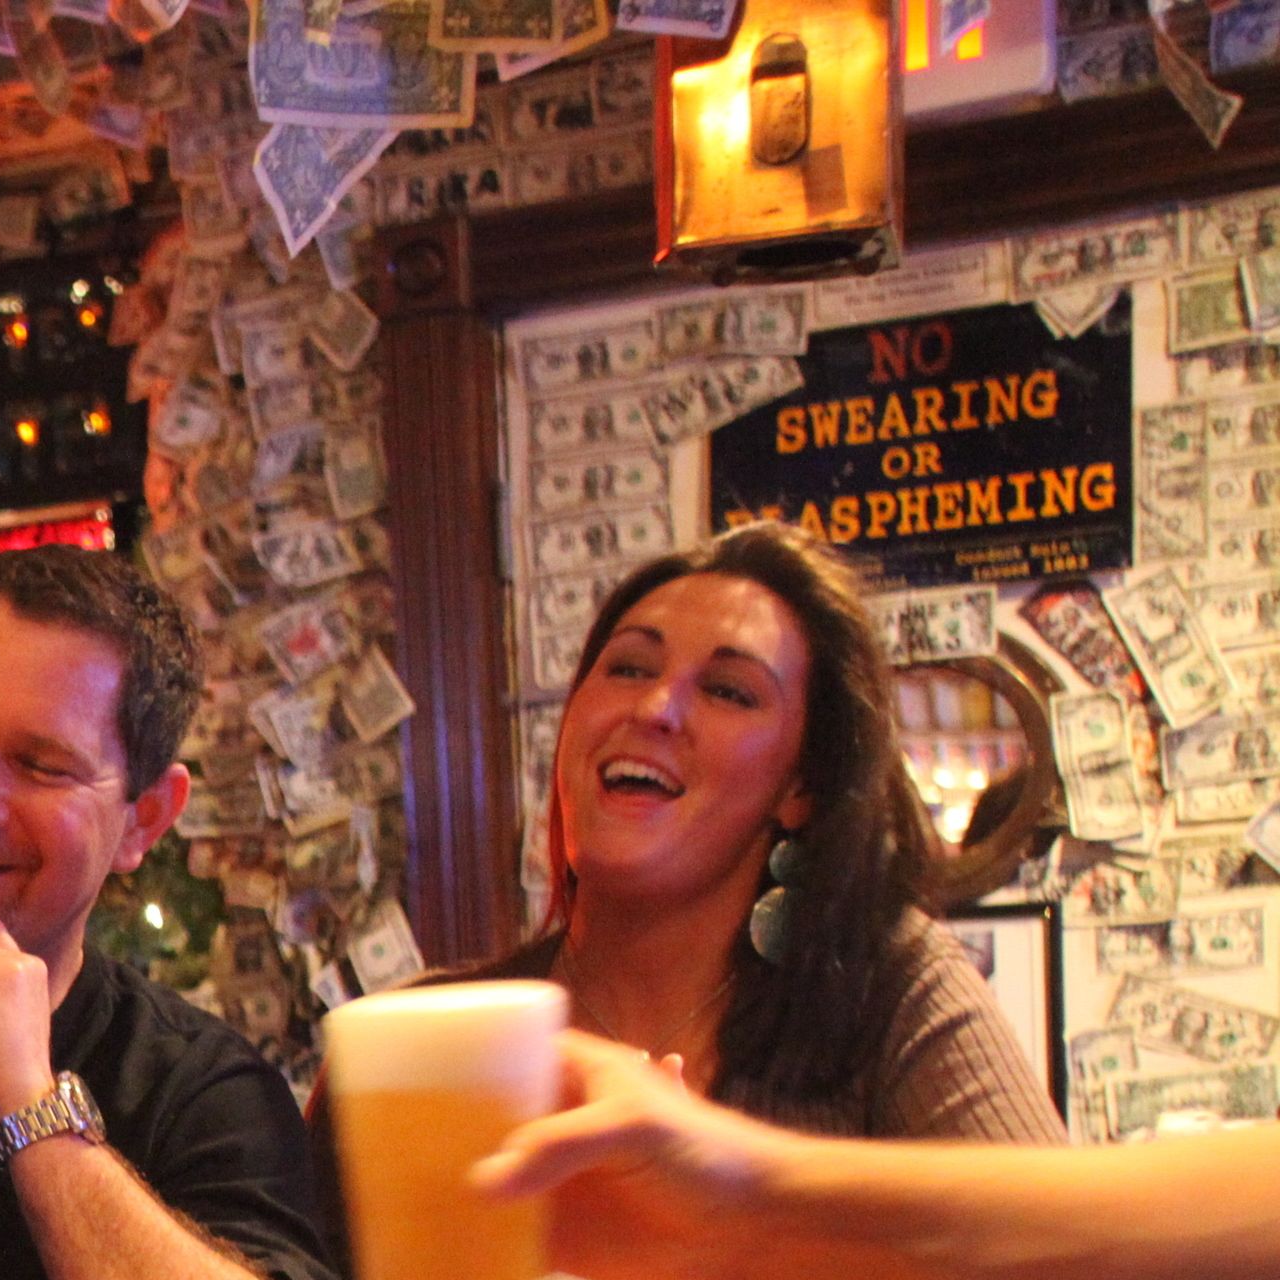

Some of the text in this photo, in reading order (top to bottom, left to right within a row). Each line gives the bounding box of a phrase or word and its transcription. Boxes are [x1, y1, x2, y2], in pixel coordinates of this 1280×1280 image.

[868, 321, 953, 384] NO
[776, 368, 1060, 454] SWEARING
[881, 442, 943, 479] OR
[724, 462, 1117, 545] ASPHEMING
